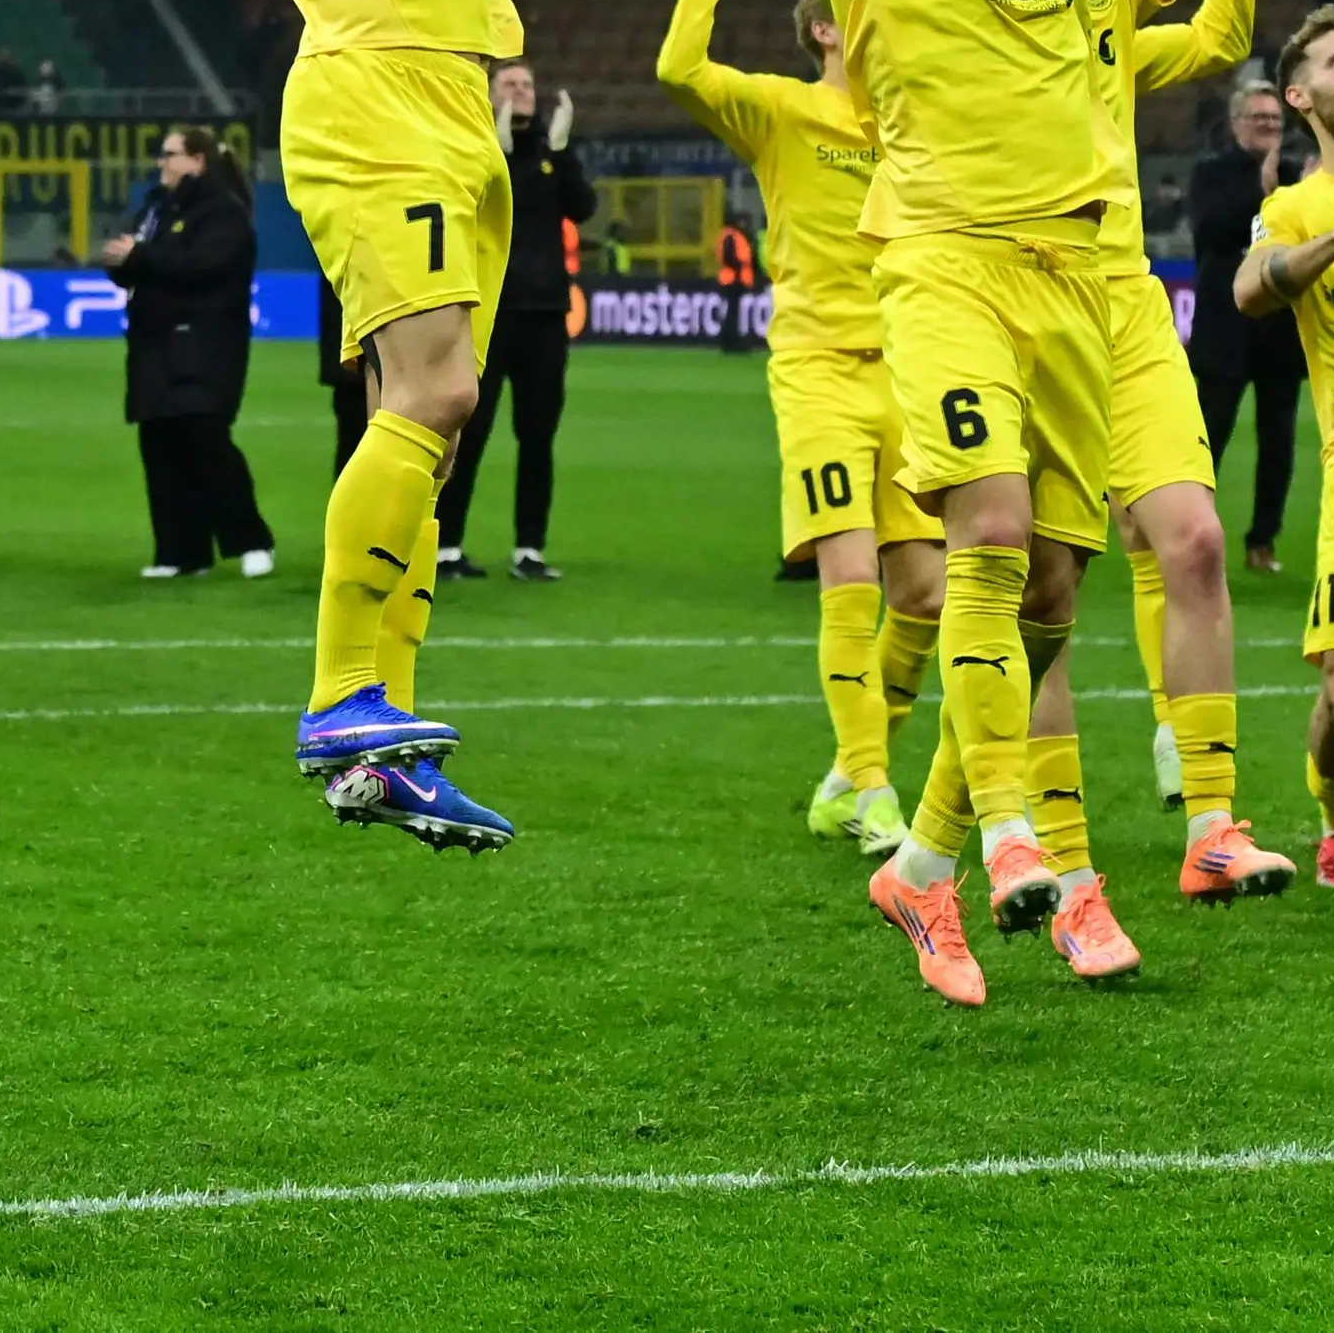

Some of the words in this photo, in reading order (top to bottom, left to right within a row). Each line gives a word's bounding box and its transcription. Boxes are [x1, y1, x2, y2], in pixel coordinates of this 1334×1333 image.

[403, 201, 445, 273] 7
[591, 283, 774, 337] mastercrd
[939, 387, 989, 450] 6
[801, 462, 852, 515] 10
